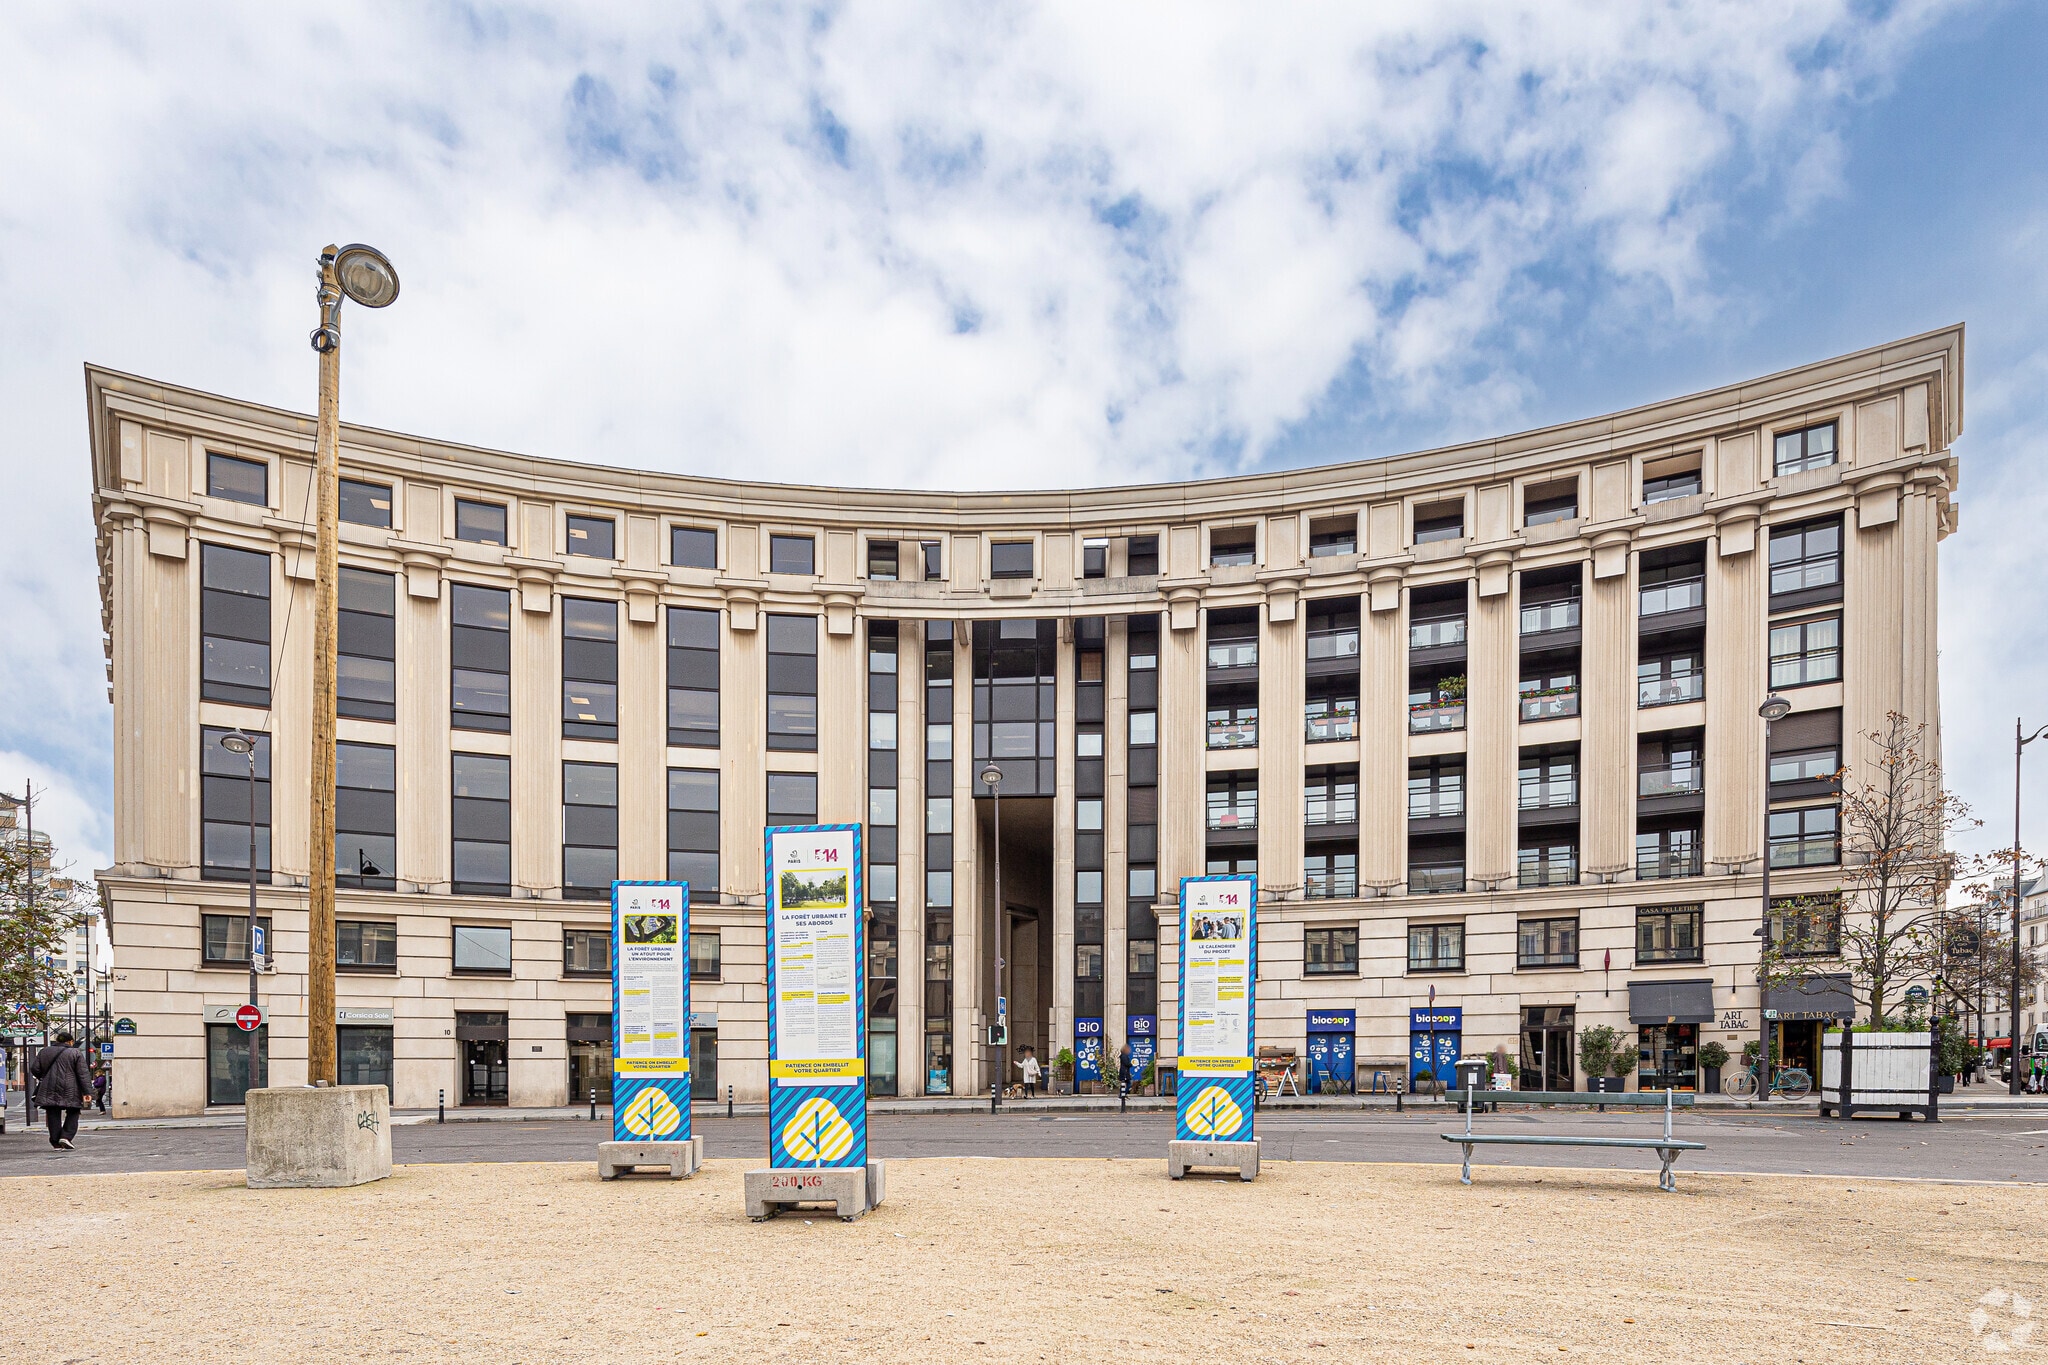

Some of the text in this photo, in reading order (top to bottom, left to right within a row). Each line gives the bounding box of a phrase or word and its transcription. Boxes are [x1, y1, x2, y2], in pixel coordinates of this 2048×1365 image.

[1661, 905, 1699, 913] PELLETIER
[256, 932, 262, 949] P
[1724, 1011, 1743, 1020] ART
[1777, 1010, 1839, 1019] ART TABAC
[1312, 1016, 1350, 1026] biocoop
[1416, 1014, 1456, 1025] biocoop
[1719, 1020, 1749, 1029] TABAC
[803, 1175, 822, 1187] KG
